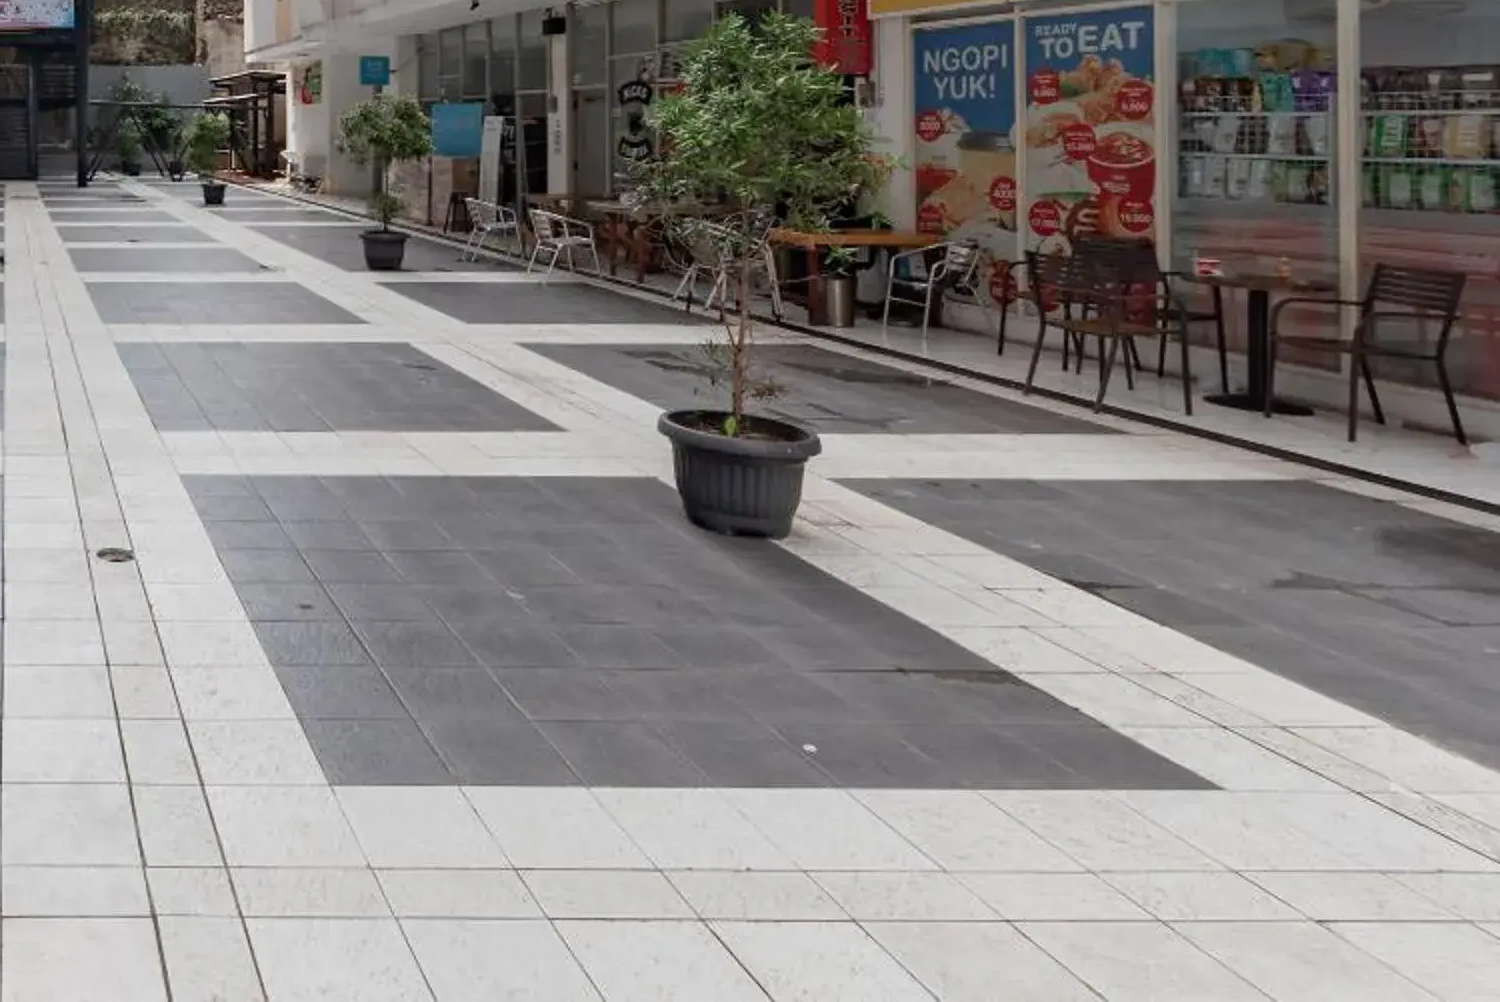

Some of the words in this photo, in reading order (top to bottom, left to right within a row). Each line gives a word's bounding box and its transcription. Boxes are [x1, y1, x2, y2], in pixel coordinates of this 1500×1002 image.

[1035, 23, 1077, 37] READY
[1039, 37, 1074, 59] TO
[1078, 22, 1145, 53] EAT
[923, 45, 1008, 74] NGOPI
[933, 74, 997, 99] YUK!
